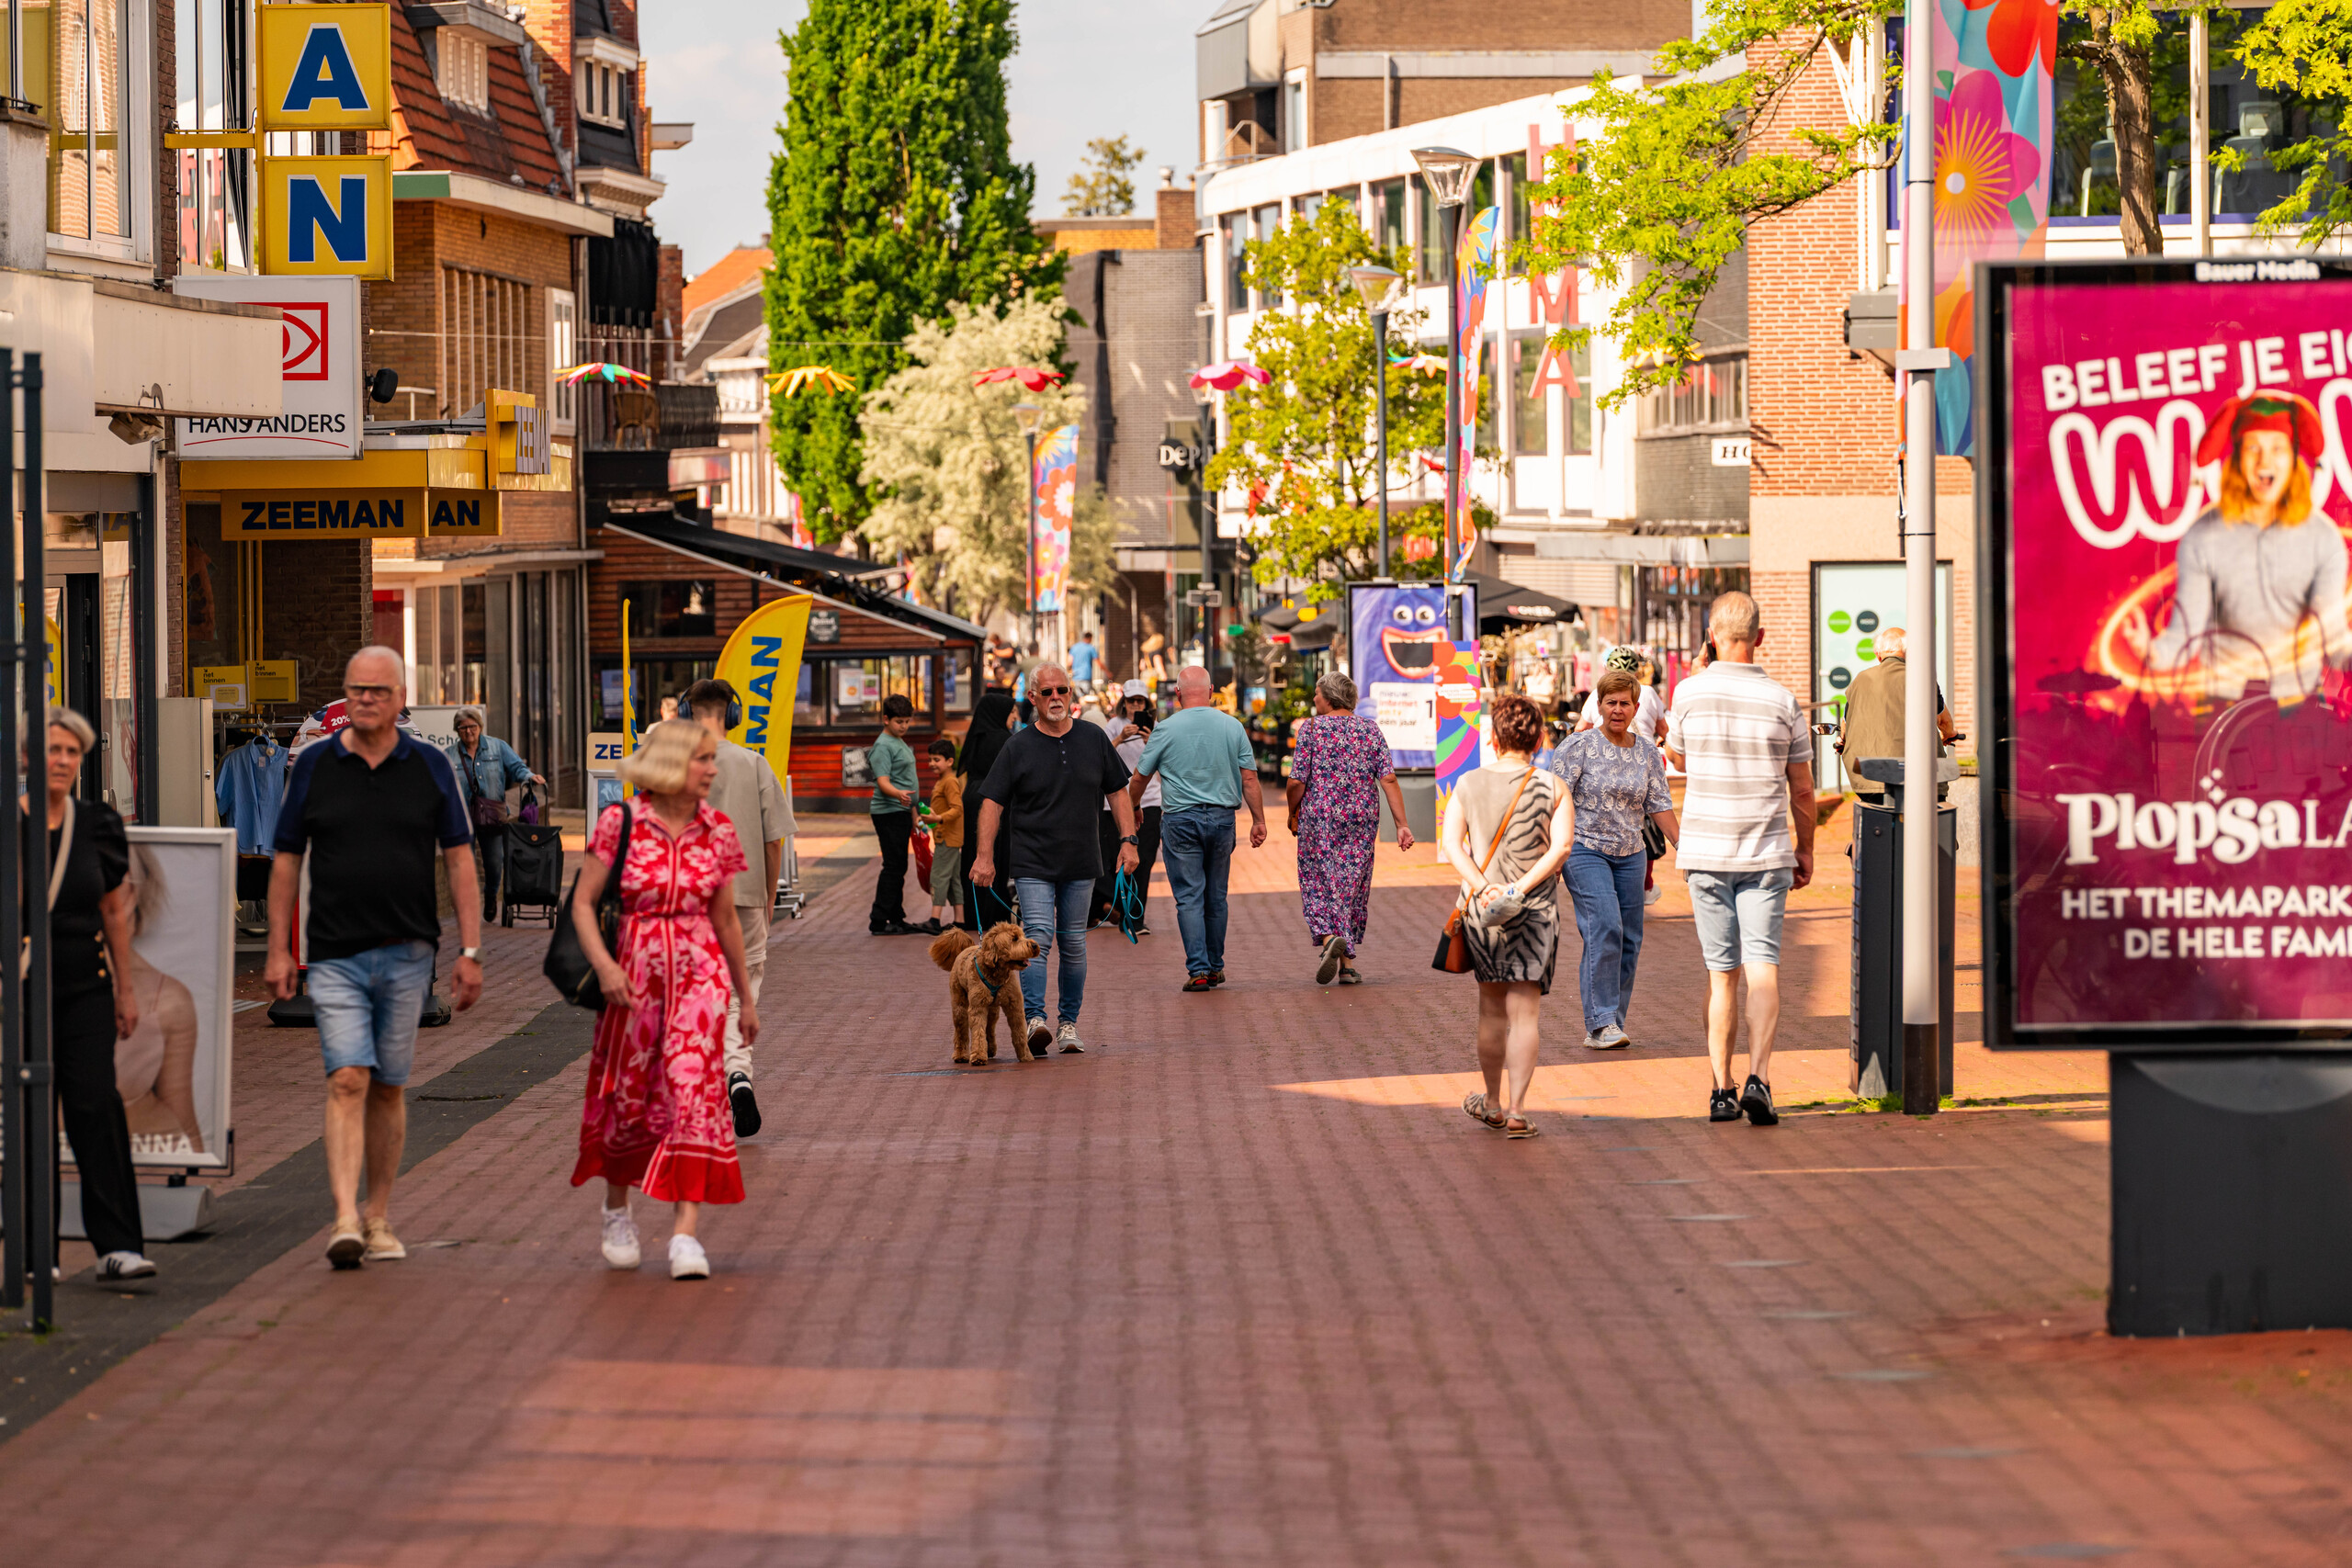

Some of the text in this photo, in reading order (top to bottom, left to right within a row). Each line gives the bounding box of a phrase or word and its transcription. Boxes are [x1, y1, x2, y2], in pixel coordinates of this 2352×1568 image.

[2195, 259, 2321, 282] Bauer Media
[2041, 328, 2352, 412] BELEEF JE EI
[188, 413, 345, 434] HANS ANDERS
[241, 499, 404, 531] ZEEMAN
[331, 714, 351, 727] 20%
[2062, 885, 2352, 919] HET THEMAPARK
[2124, 927, 2172, 959] DE
[2177, 926, 2265, 958] HELE
